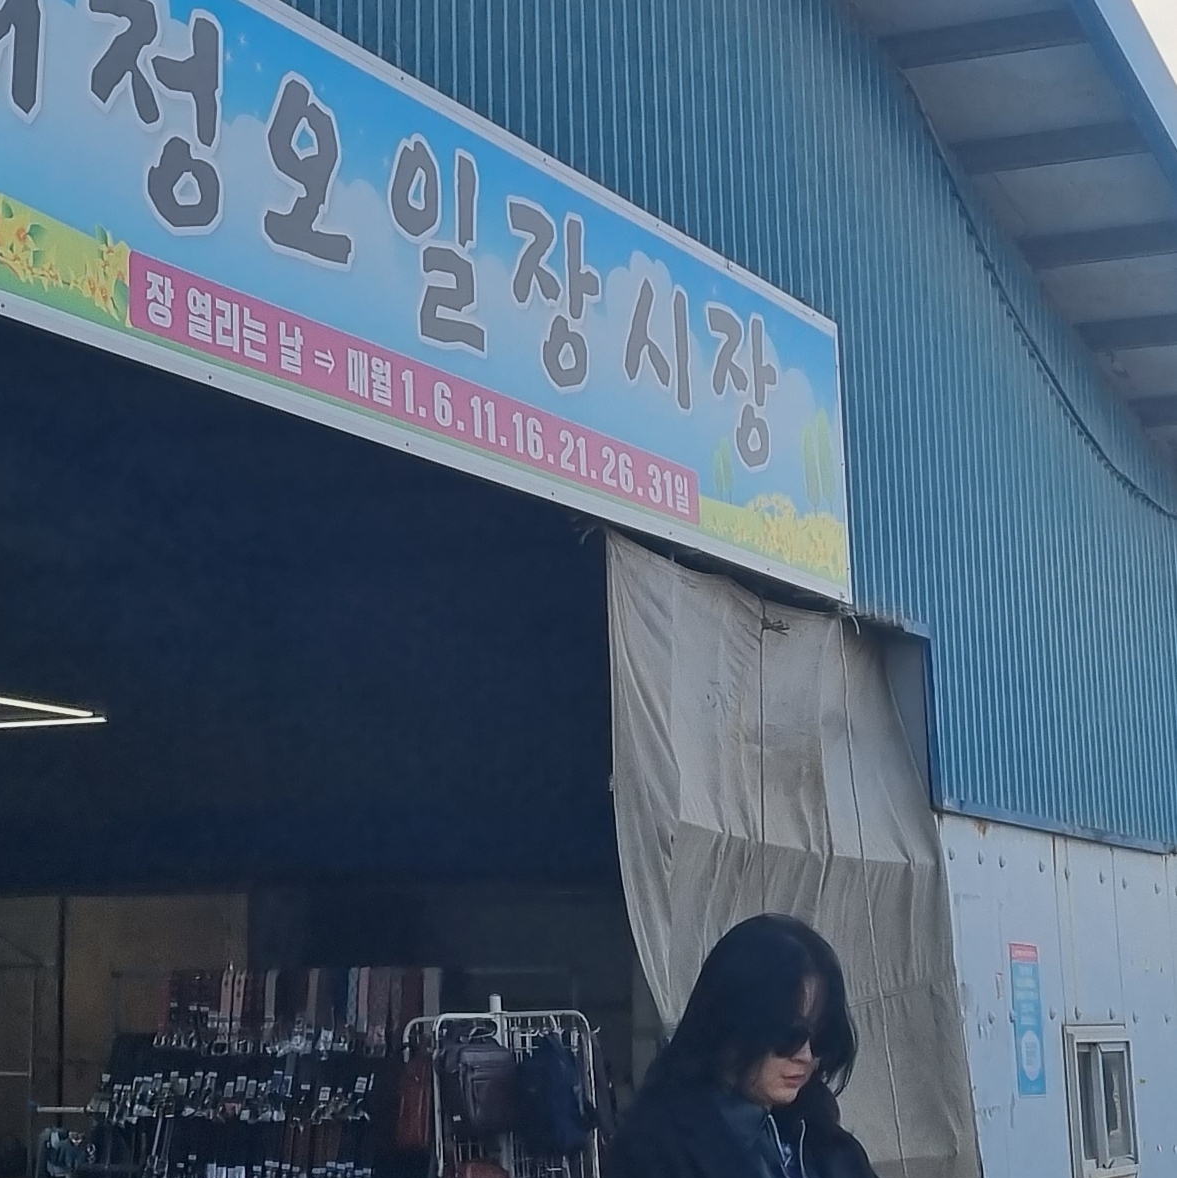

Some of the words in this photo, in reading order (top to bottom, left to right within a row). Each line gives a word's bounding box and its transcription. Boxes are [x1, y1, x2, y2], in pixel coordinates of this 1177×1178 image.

[145, 270, 174, 329] 장
[186, 286, 267, 363] 열리는
[278, 321, 304, 375] 날
[347, 347, 393, 407] 매월
